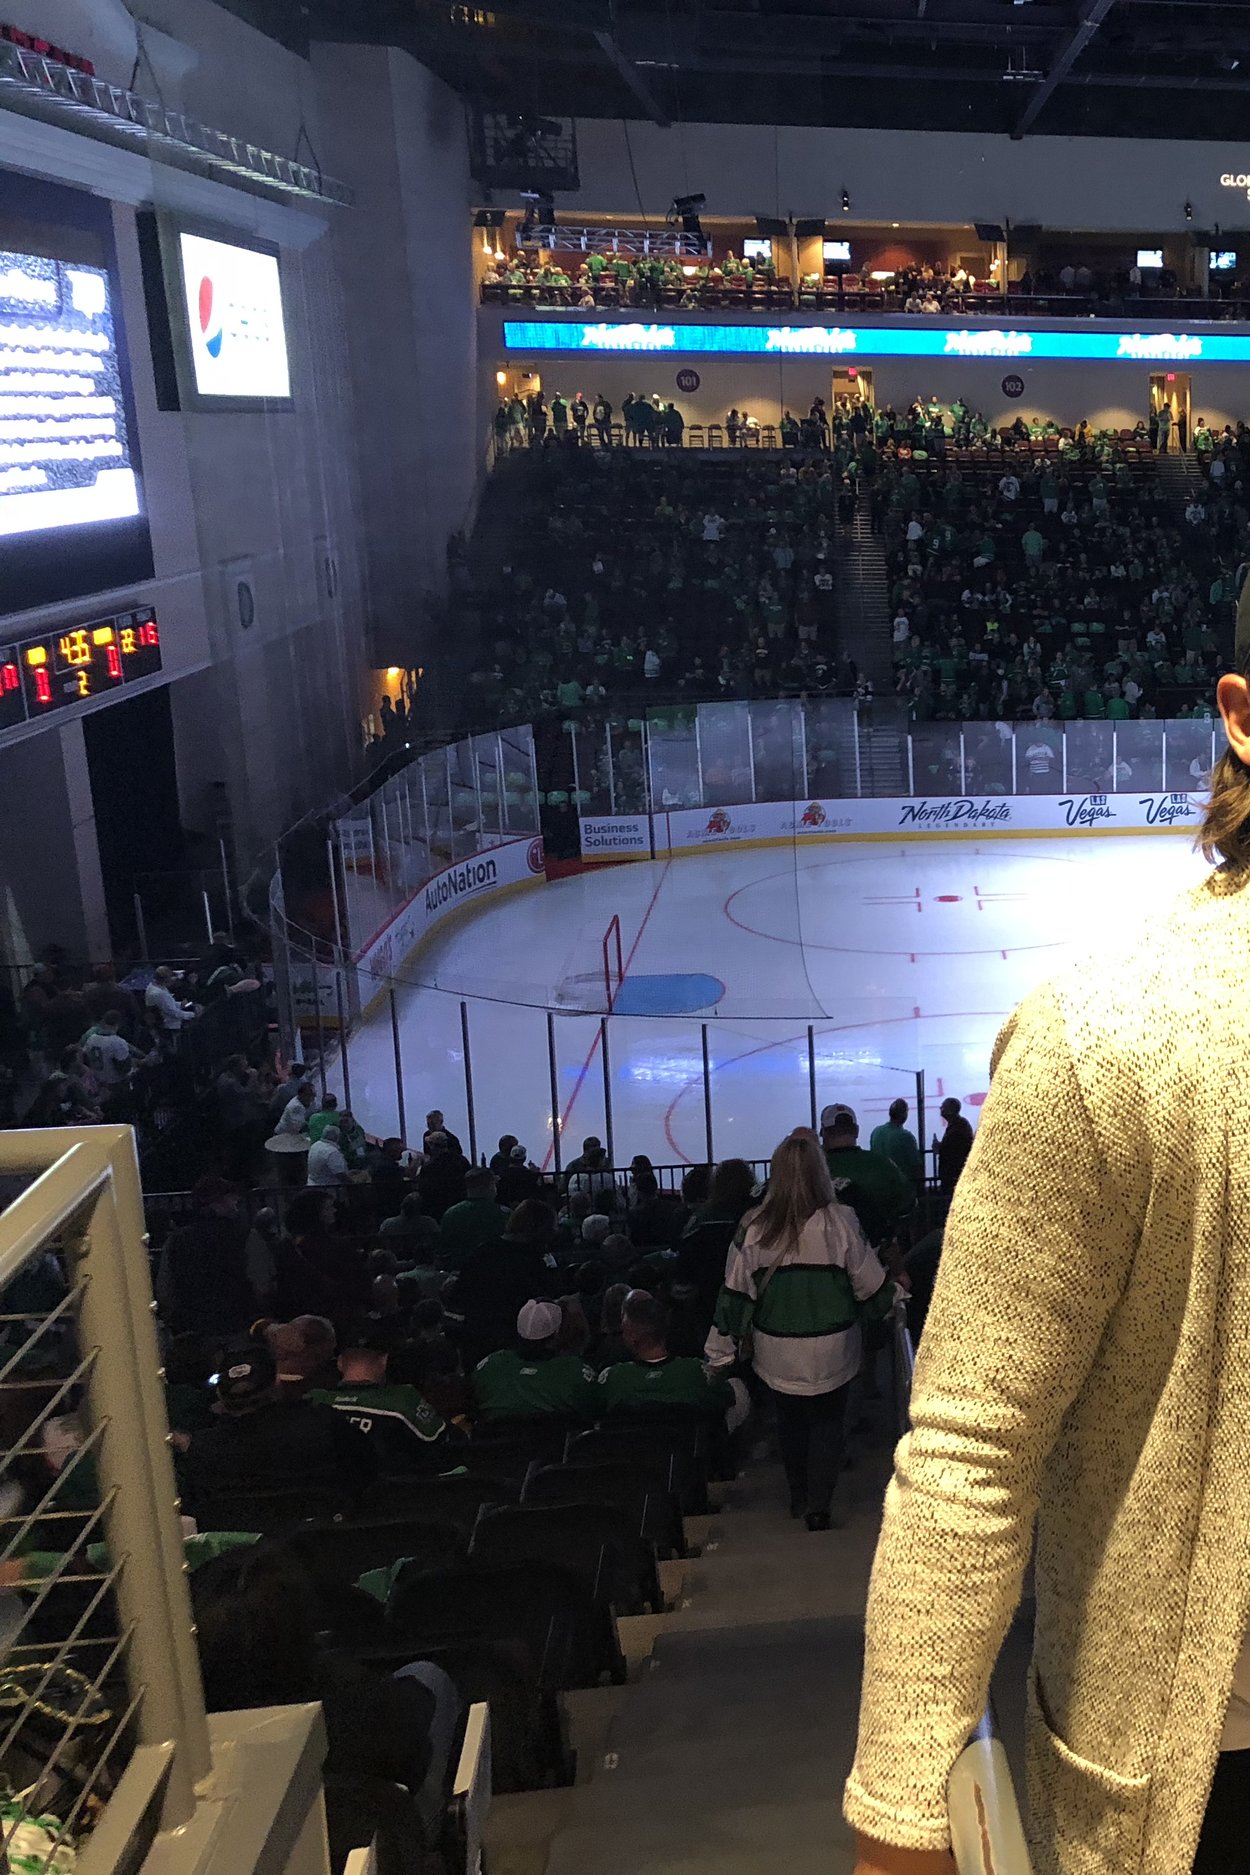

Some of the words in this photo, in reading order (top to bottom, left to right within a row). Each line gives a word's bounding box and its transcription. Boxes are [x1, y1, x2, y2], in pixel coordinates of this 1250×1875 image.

[680, 376, 697, 387] 101
[1005, 381, 1022, 391] 102
[899, 801, 951, 825] North
[944, 800, 1014, 821] Dakota
[1058, 797, 1117, 826] Vegas
[1139, 796, 1197, 825] Vegas
[584, 823, 639, 835] Business
[584, 834, 645, 848] Solutions
[425, 859, 497, 916] AutoNation
